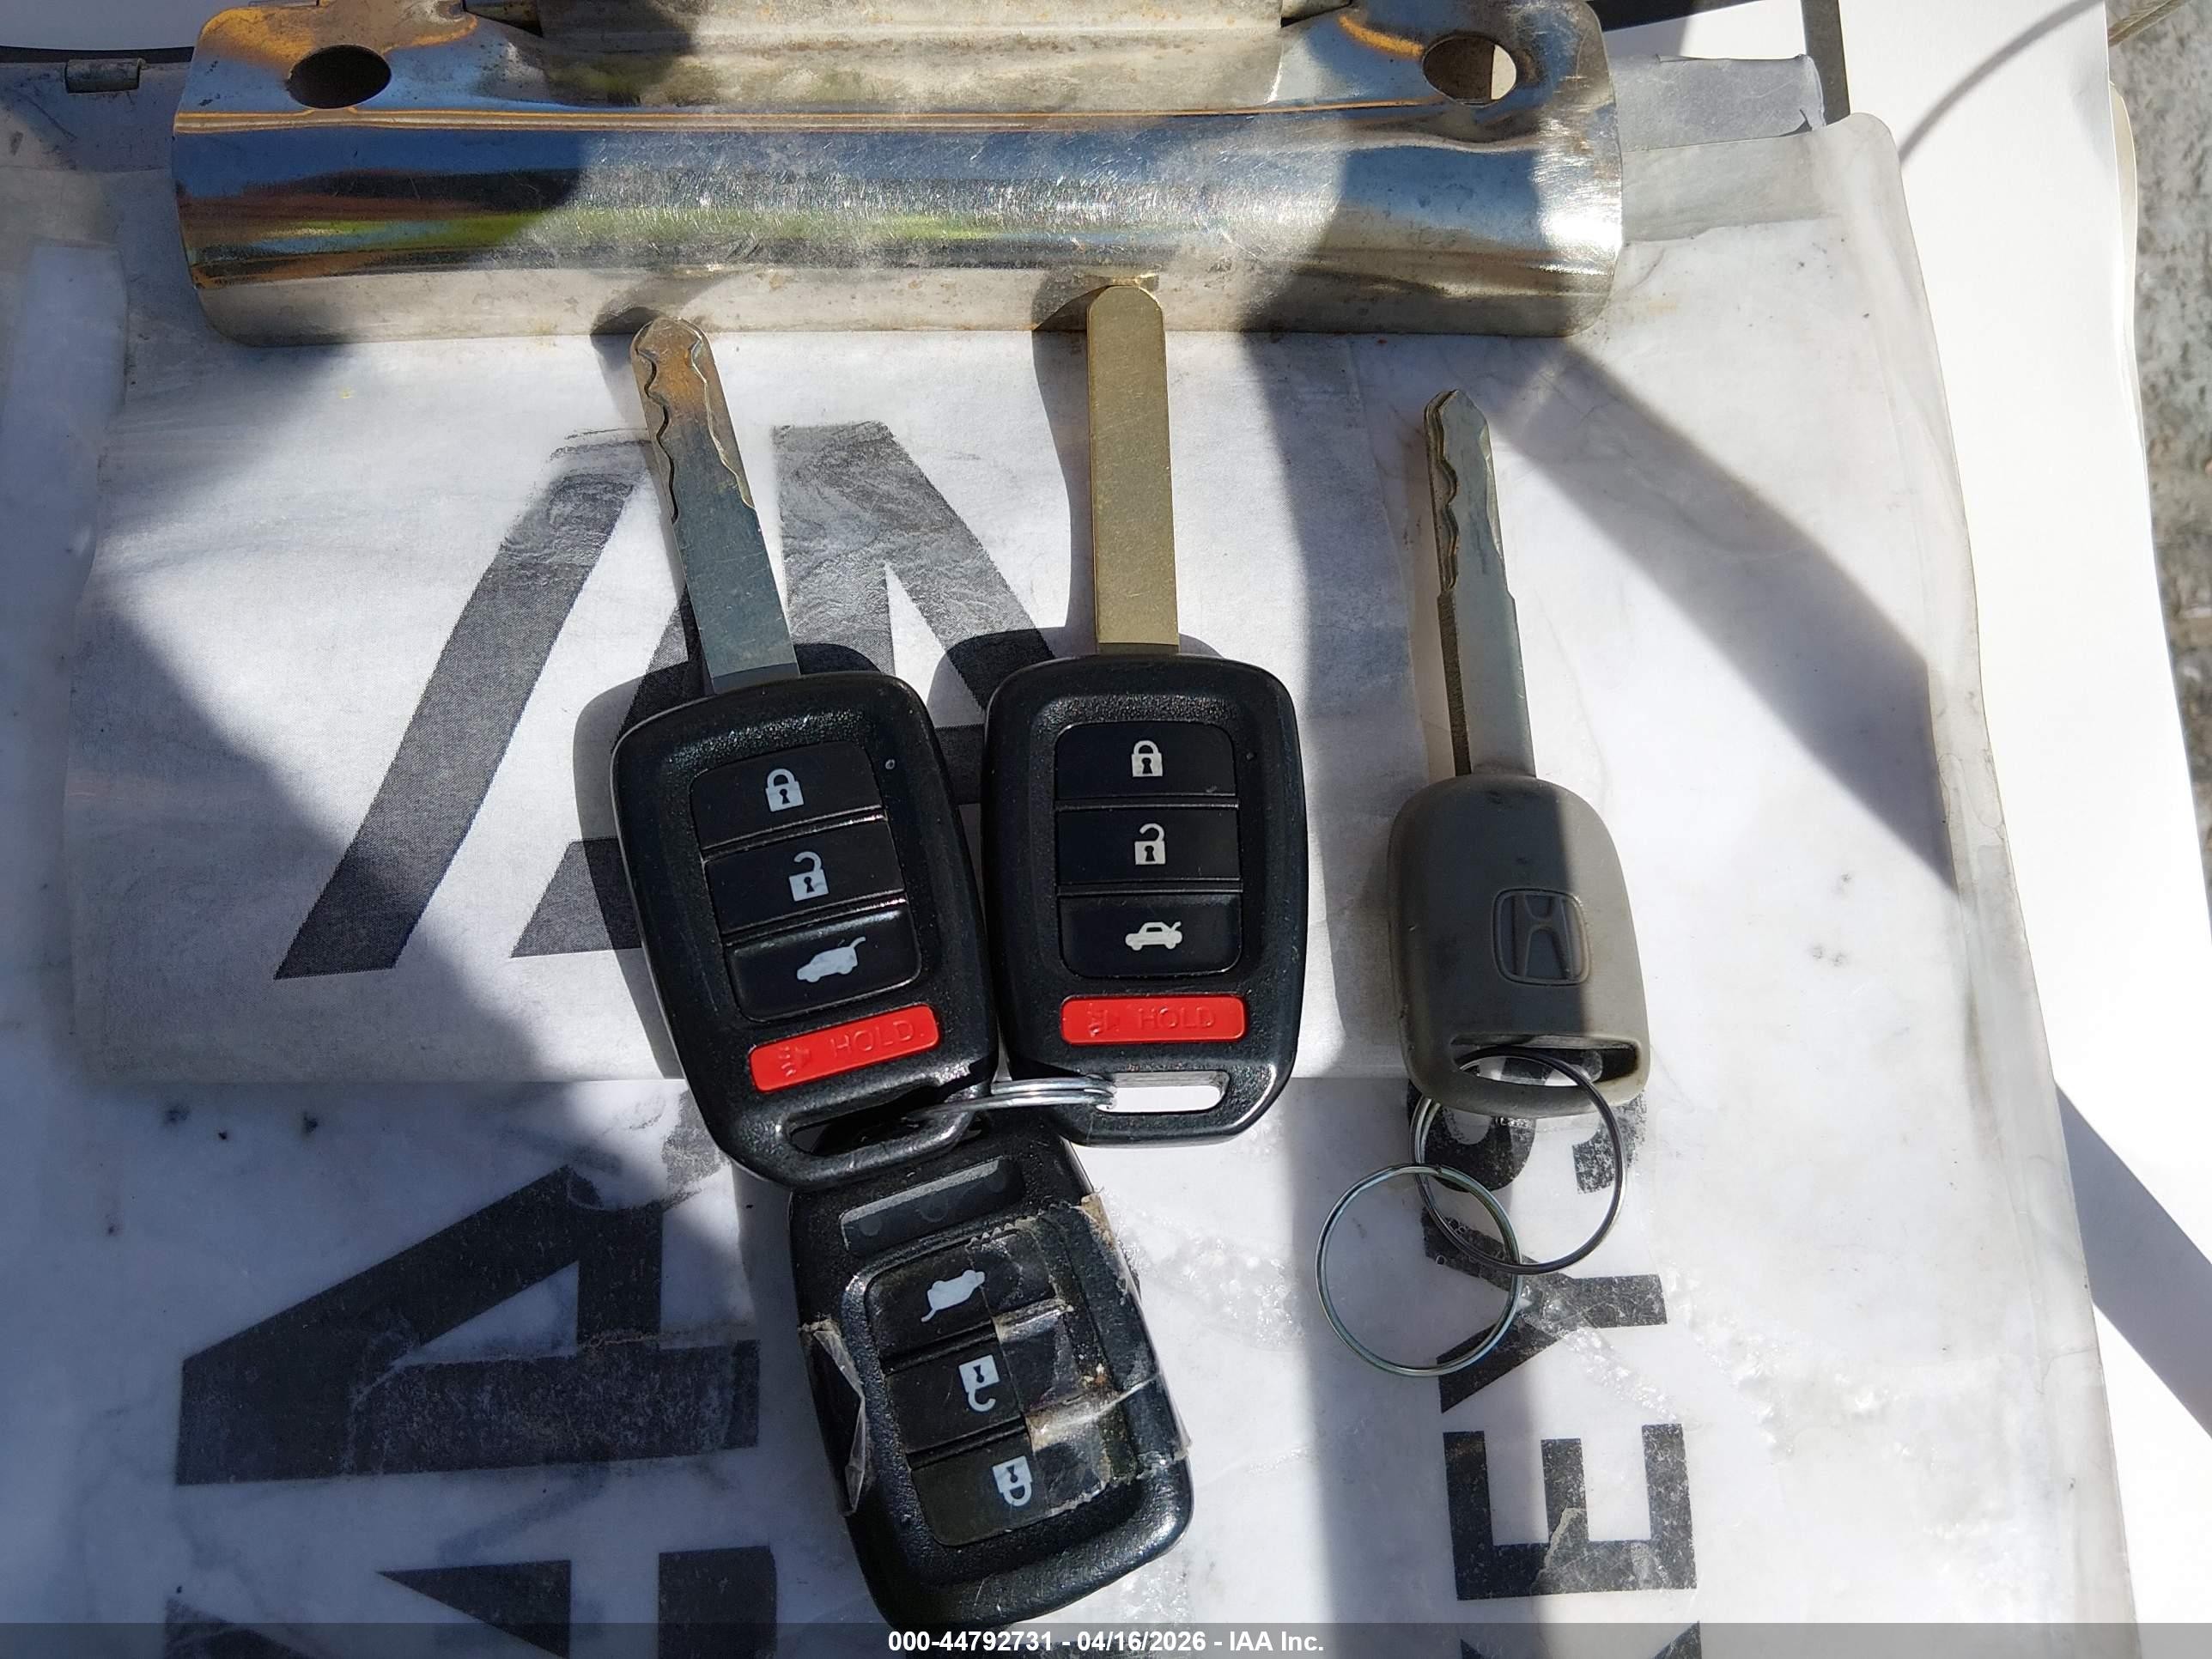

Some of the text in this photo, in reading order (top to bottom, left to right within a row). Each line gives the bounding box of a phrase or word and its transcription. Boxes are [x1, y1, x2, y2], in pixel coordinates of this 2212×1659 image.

[1138, 1006, 1216, 1031] HOLD
[830, 1019, 915, 1059] HOLD
[1406, 1048, 1701, 1659] EYS
